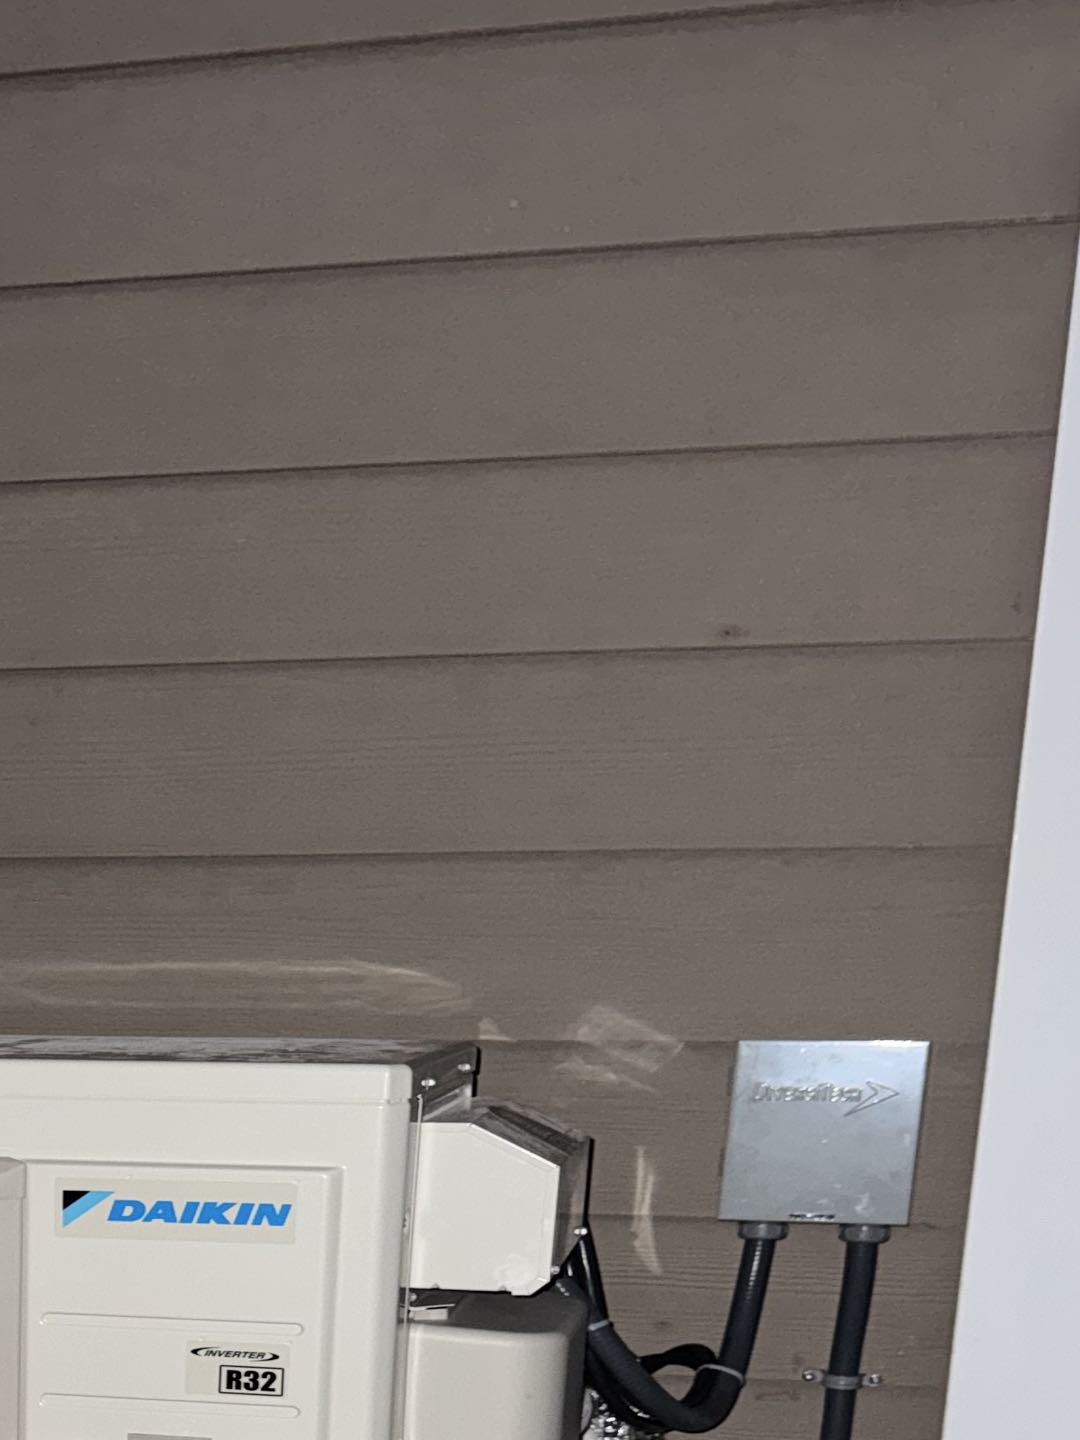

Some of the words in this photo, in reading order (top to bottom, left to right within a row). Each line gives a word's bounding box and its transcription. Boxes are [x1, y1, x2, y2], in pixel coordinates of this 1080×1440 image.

[107, 1199, 292, 1227] DAIKIN
[204, 1349, 266, 1360] INVERTER
[225, 1369, 277, 1392] R32
